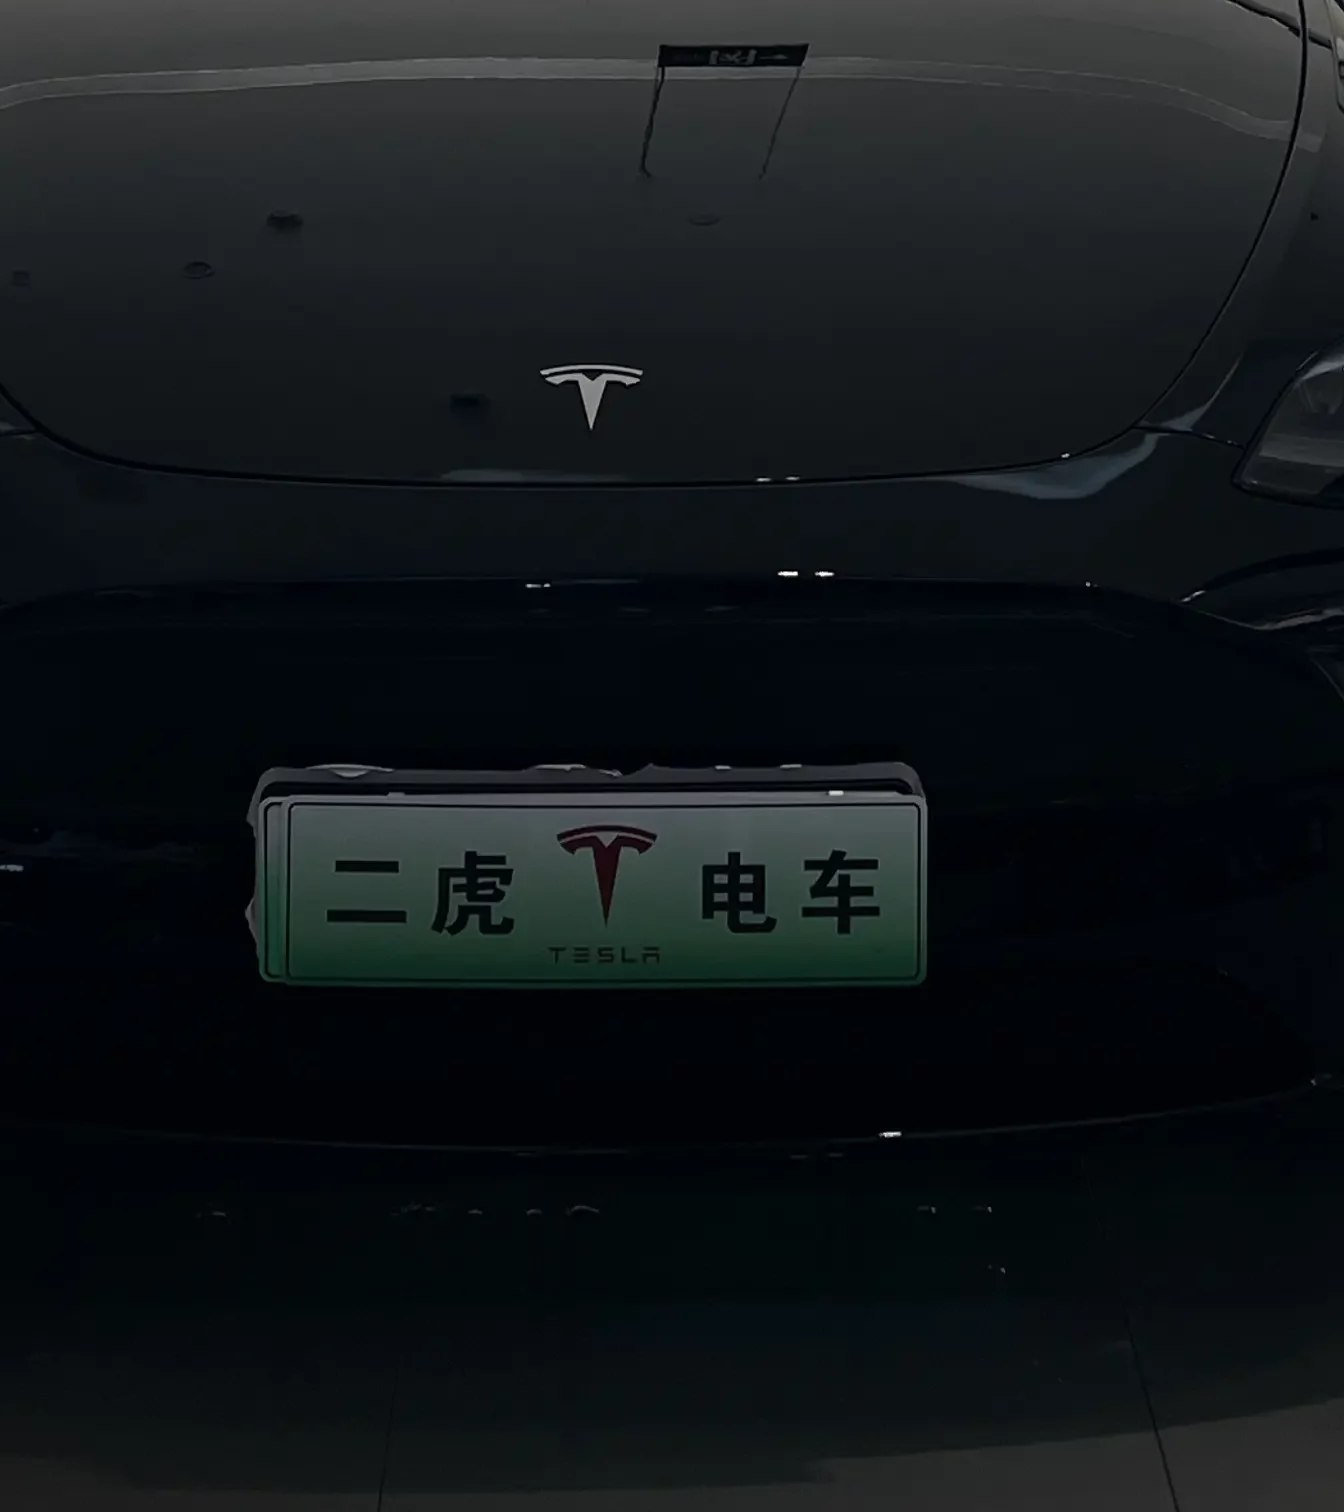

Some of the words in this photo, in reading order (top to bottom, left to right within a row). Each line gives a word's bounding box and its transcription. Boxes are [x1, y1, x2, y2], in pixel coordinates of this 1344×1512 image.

[326, 850, 515, 937] 二虎
[701, 849, 881, 935] 电车
[548, 946, 661, 965] TESLA
